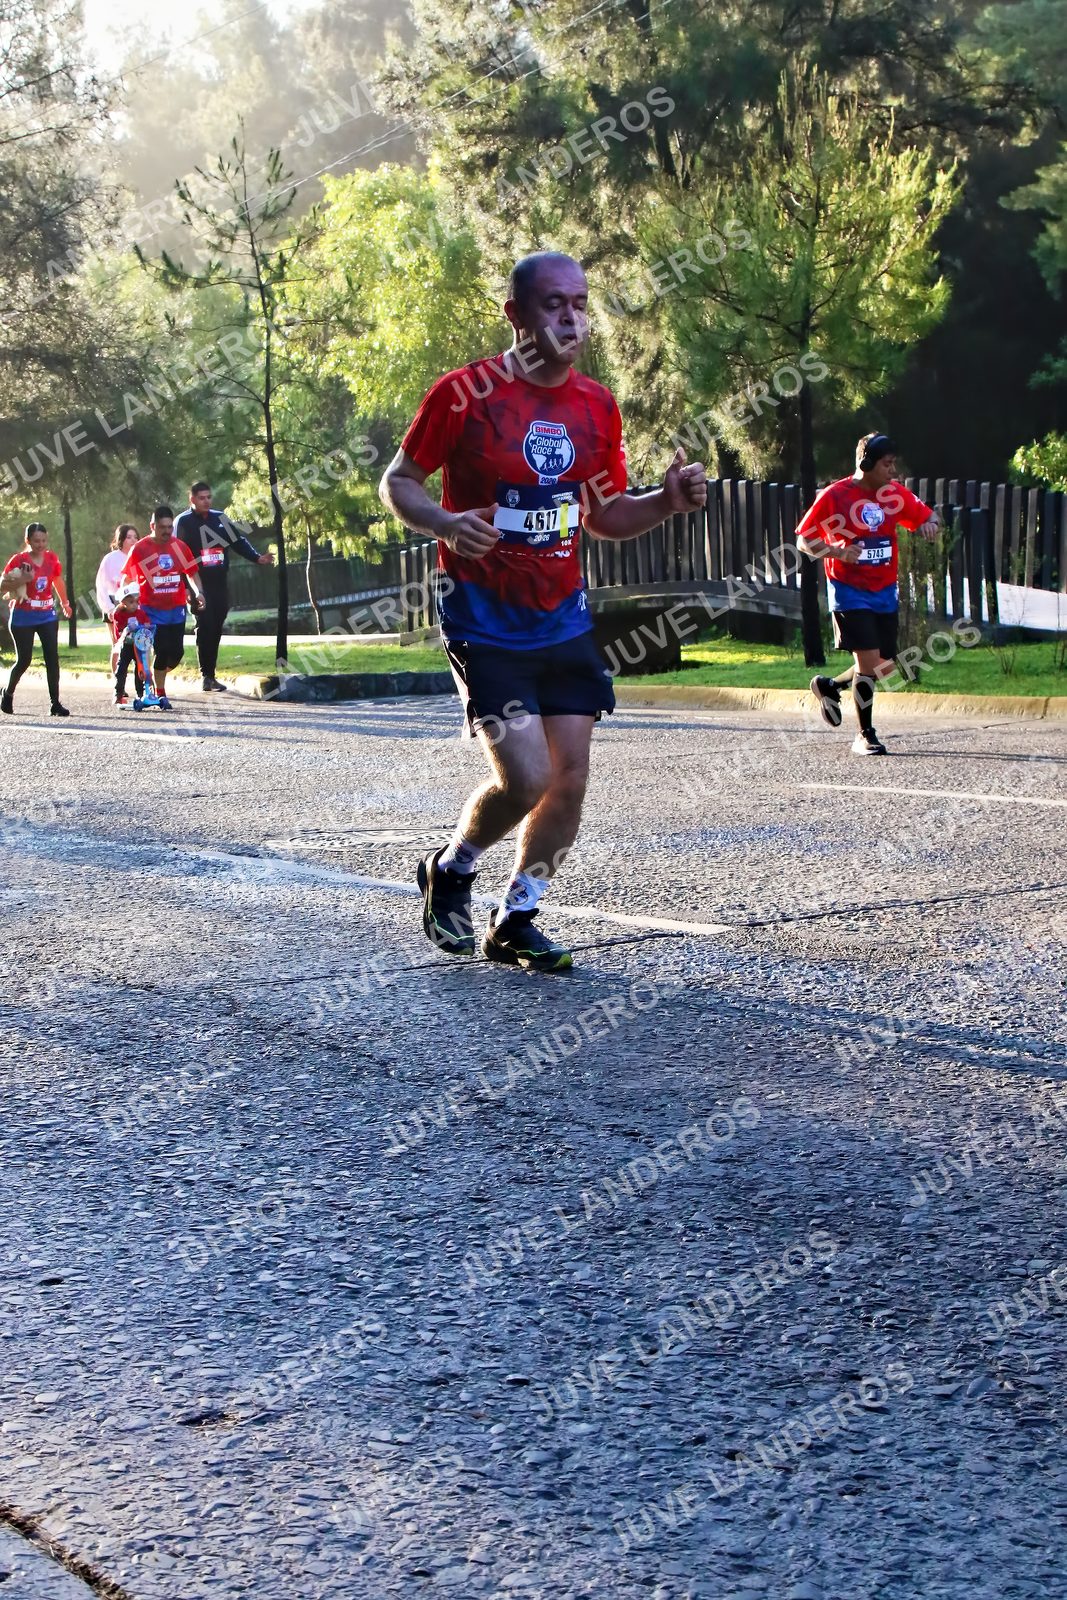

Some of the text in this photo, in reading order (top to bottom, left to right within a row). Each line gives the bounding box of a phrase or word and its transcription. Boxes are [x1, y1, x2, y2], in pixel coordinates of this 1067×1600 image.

[535, 426, 561, 435] BIMBO
[536, 436, 562, 448] Global
[531, 444, 552, 455] Race
[523, 509, 558, 532] 4617
[867, 548, 884, 559] 5743
